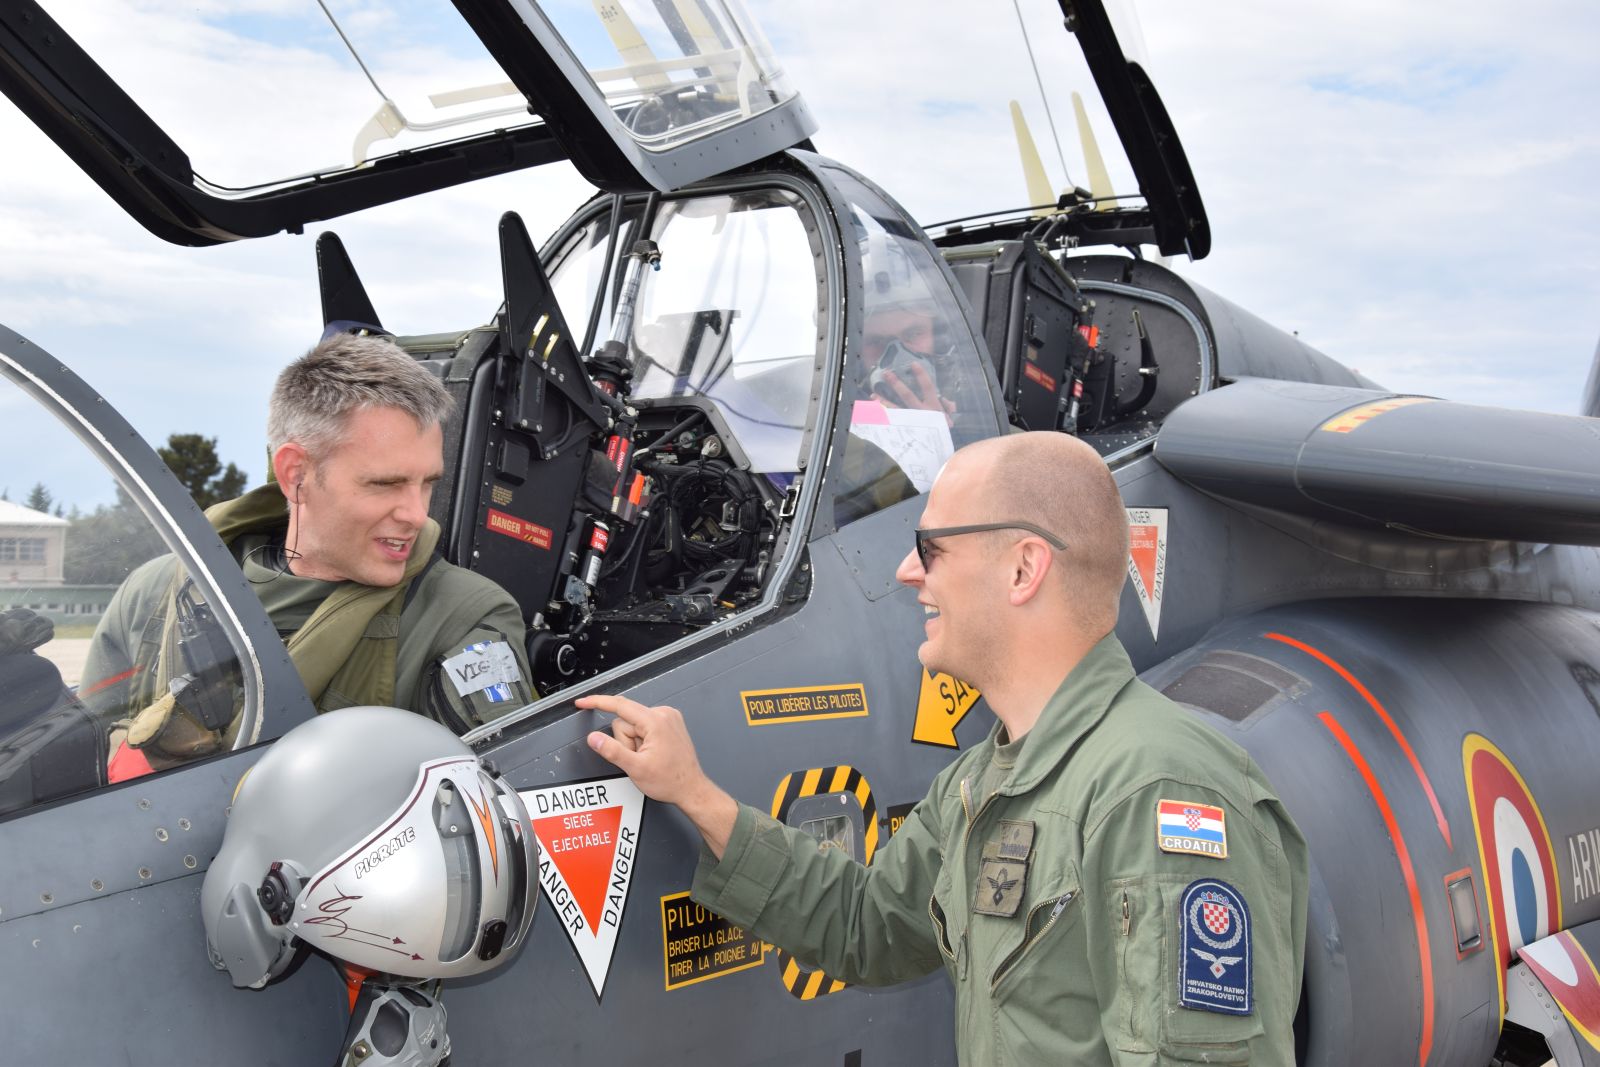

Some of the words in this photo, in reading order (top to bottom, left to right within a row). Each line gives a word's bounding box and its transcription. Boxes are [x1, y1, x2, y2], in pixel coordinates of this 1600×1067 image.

[491, 514, 521, 535] DANGER
[1129, 511, 1151, 523] NGER
[1128, 560, 1147, 599] NGER
[1154, 539, 1165, 601] DANGER
[749, 700, 776, 715] POUR
[812, 695, 829, 710] LES
[829, 693, 862, 709] PILOTES
[939, 677, 975, 716] SA
[536, 785, 609, 814] DANGER
[563, 814, 594, 830] SIEGE
[354, 826, 416, 879] PICRATE
[552, 831, 612, 853] EJECTABLE
[1164, 837, 1221, 854] CROATIA
[604, 827, 636, 927] DANGER
[667, 903, 724, 931] PILO
[668, 935, 700, 957] BRISER
[702, 932, 715, 948] LA
[716, 926, 744, 945] GLACE
[670, 959, 693, 978] TIRER
[698, 955, 710, 970] LA
[1187, 979, 1222, 991] HRVATSKO
[1223, 985, 1245, 995] RATNO
[1187, 986, 1244, 1002] ZRAKOPLOVSTVO
